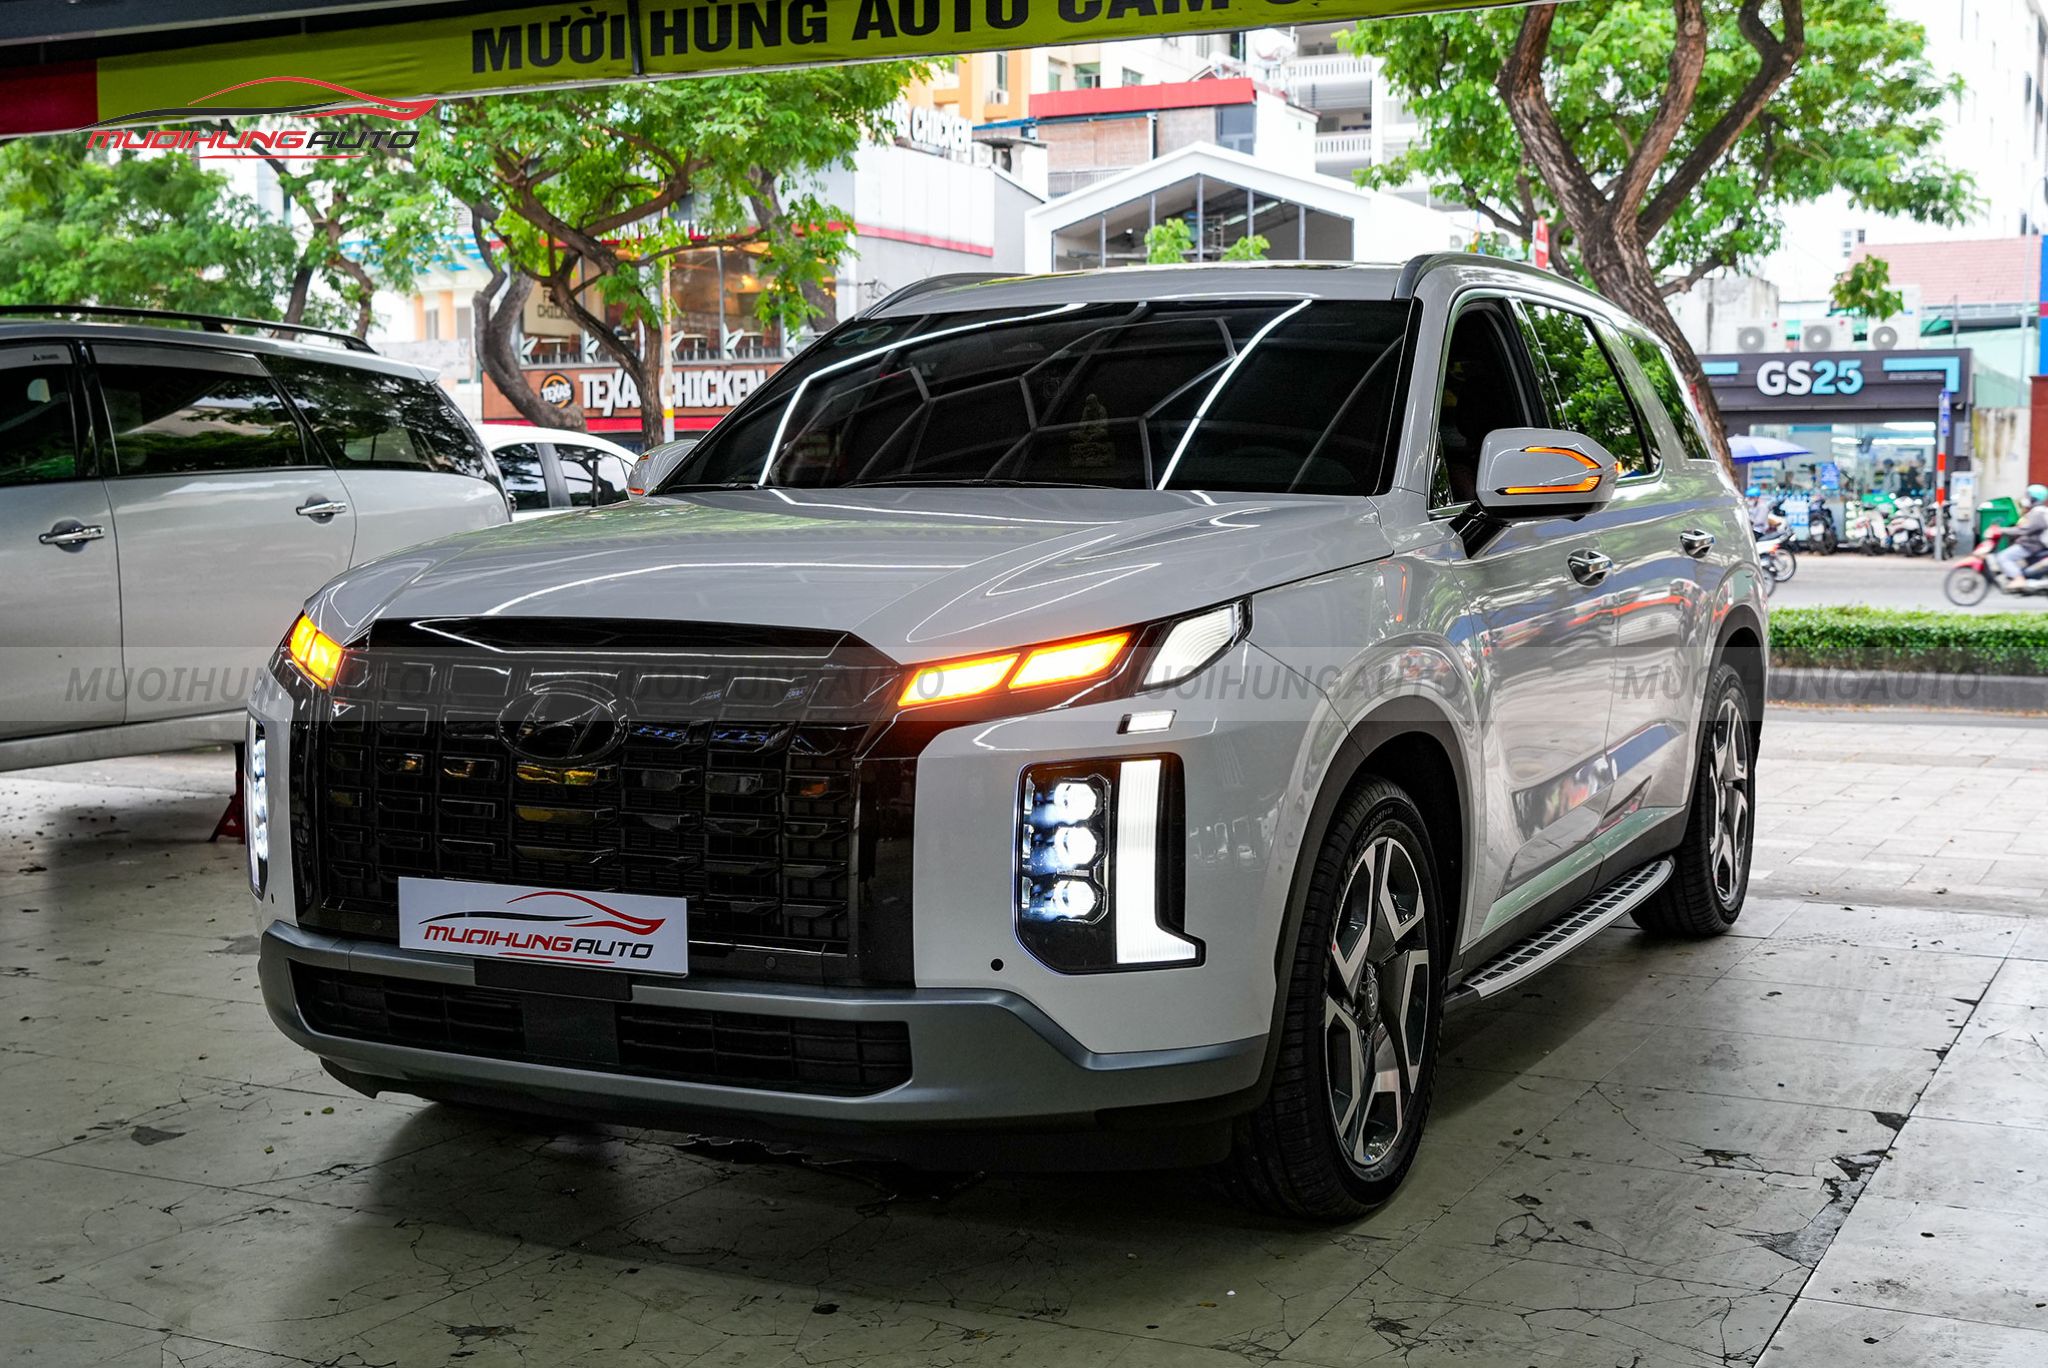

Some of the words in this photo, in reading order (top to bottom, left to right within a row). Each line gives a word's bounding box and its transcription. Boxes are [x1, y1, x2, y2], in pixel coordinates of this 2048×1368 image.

[472, 7, 625, 73] MƯỜI
[541, 383, 572, 403] TEXAS
[579, 368, 642, 417] TEXA
[1756, 359, 1864, 396] GS25
[424, 925, 654, 959] MUOIHUNGAUTO
